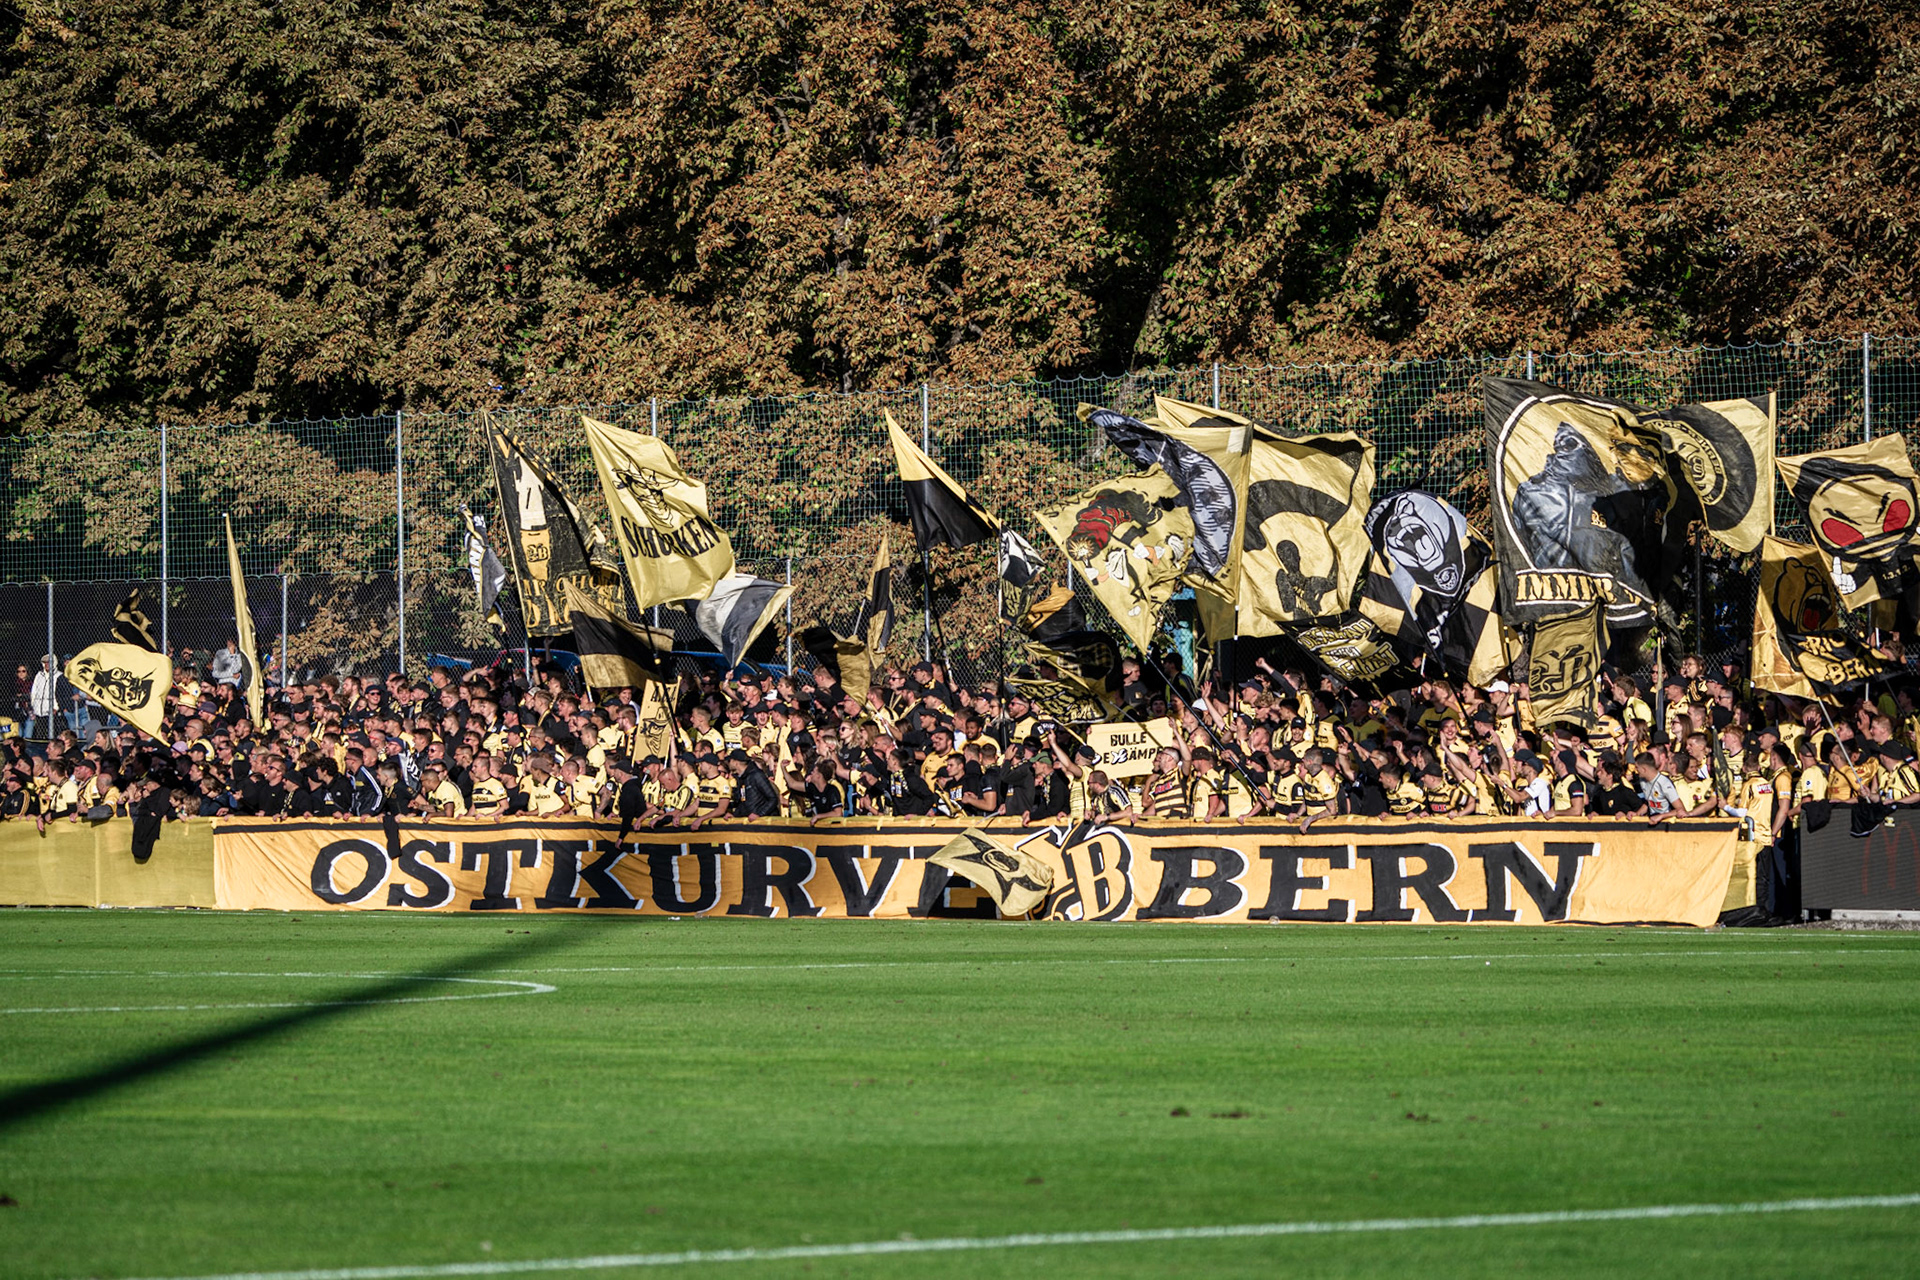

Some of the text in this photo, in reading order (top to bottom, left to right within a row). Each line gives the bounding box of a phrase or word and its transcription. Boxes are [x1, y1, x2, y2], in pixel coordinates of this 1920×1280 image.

[621, 514, 721, 558] SCHURKEN
[1517, 573, 1618, 603] IMMER
[1110, 731, 1147, 747] BULLE
[1137, 840, 1601, 926] BERN
